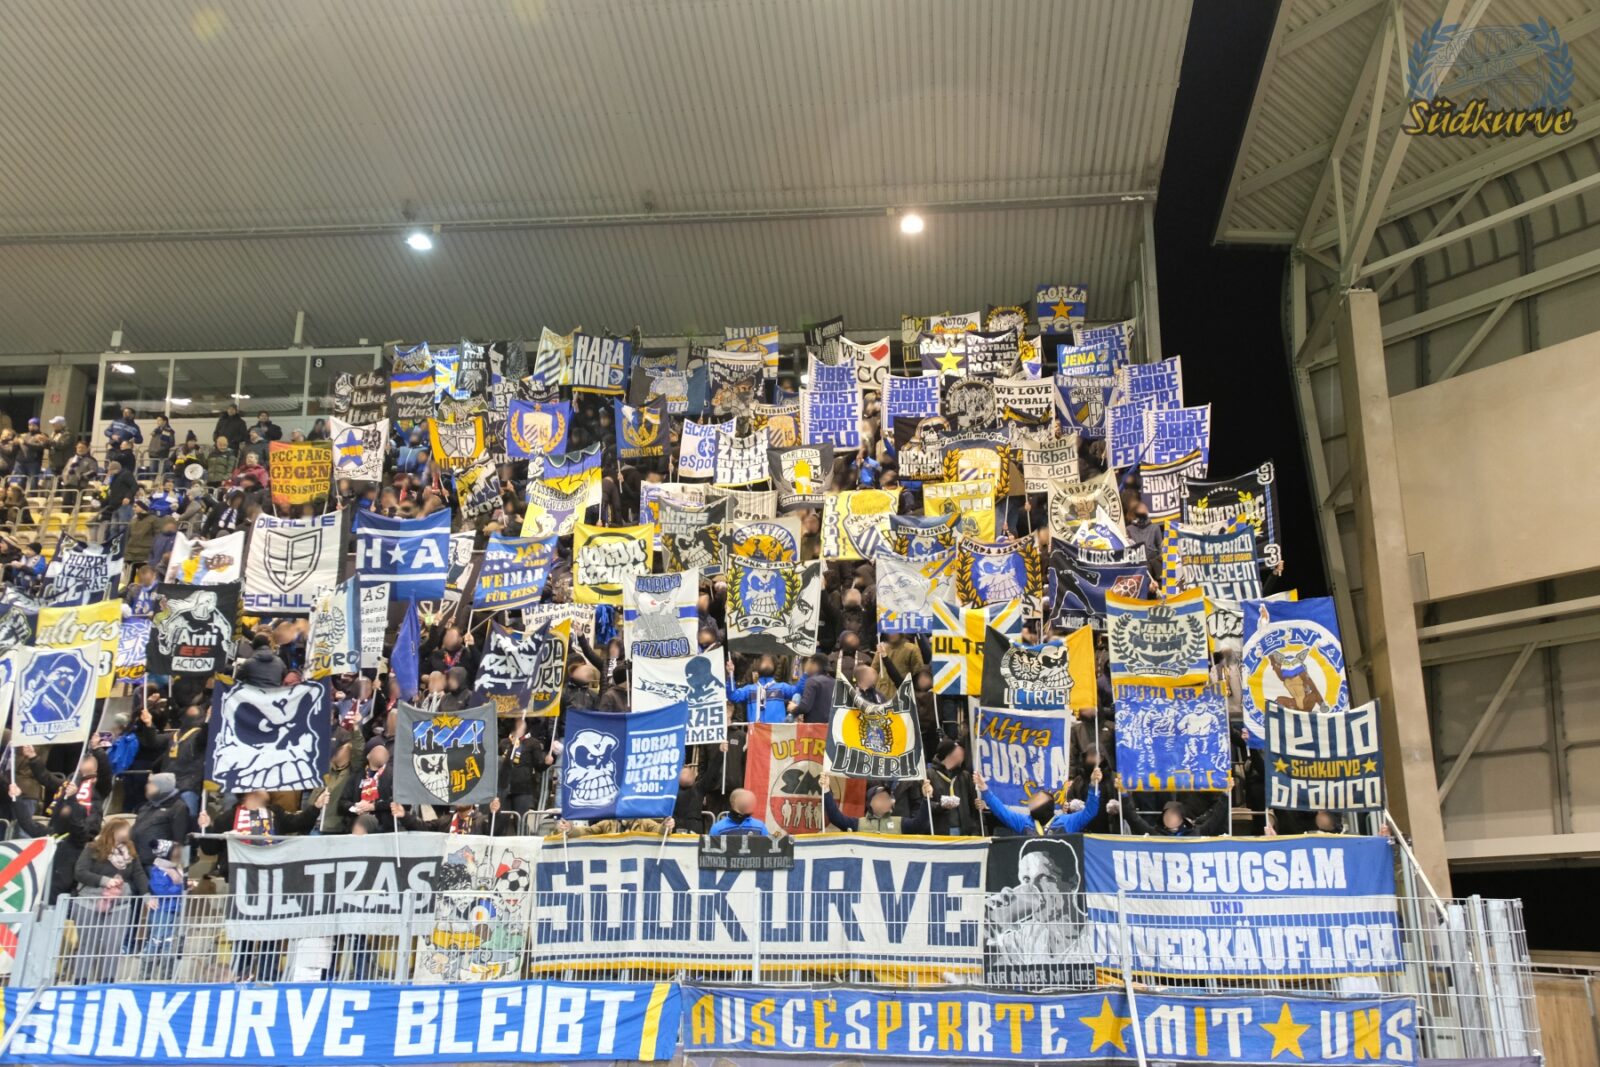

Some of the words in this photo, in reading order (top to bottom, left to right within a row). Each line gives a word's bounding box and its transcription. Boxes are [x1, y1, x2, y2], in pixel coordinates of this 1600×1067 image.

[1037, 285, 1087, 303] FORZA
[1082, 323, 1125, 340] ERNST
[576, 335, 625, 366] HARA
[967, 343, 1017, 354] FOOTBALL
[967, 352, 993, 362] NOT
[314, 358, 323, 368] 8
[462, 361, 486, 370] DICH
[1061, 351, 1097, 368] JENA
[1128, 358, 1178, 377] ERNST
[574, 359, 611, 388] KIRI
[815, 366, 856, 382] ABBE
[1056, 374, 1119, 388] TRADITION
[889, 376, 938, 390] ERNST
[995, 386, 1014, 395] WE
[1018, 385, 1052, 396] LOVE
[1129, 373, 1179, 395] ABBE
[810, 391, 857, 404] ERNST
[888, 388, 938, 403] ABBE
[996, 397, 1053, 405] FOOTBALL
[810, 404, 858, 419] ABBE
[887, 401, 938, 414] SPORT
[1112, 399, 1154, 418] ERNST
[1154, 407, 1208, 423] ERNST
[685, 419, 736, 438] SCHESS
[809, 419, 858, 432] SPORT
[1090, 427, 1106, 436] 190
[1111, 415, 1144, 435] ABB
[1154, 420, 1209, 439] ABBE
[809, 431, 859, 448] FELD
[1039, 438, 1067, 450] kein
[1111, 432, 1144, 449] SPOR
[1154, 436, 1208, 452] SPORT
[271, 449, 331, 463] FCC-FANS
[1026, 449, 1076, 464] fußball
[1111, 446, 1144, 468] FEL
[271, 465, 330, 479] GEGEN
[1047, 464, 1072, 477] den
[1257, 462, 1275, 486] 9
[256, 516, 278, 529] DIE
[356, 538, 383, 569] H
[411, 538, 446, 569] A
[961, 538, 992, 555] HORDA
[1077, 548, 1116, 563] ULTRAS
[1263, 543, 1282, 568] 3
[482, 568, 545, 589] WEIMAR
[243, 593, 312, 609] SCHUL
[484, 590, 507, 603] FÜR
[510, 584, 538, 599] ZEISS
[36, 609, 120, 645] ultras
[740, 616, 785, 628] GANG
[1141, 622, 1178, 634] JENA
[177, 628, 218, 647] Anti
[1143, 633, 1172, 643] CITY
[934, 637, 985, 656] ULTR
[1244, 626, 1343, 677] JENA
[174, 657, 213, 670] ACTION
[631, 732, 678, 755] HORDA
[772, 737, 826, 761] ULTR
[626, 748, 680, 771] AZZURO
[978, 739, 1068, 789] CURVA
[624, 764, 678, 785] ULTRAS
[1290, 758, 1361, 779] Südkurve
[634, 782, 661, 794] 2001
[1271, 775, 1385, 811] branco
[1111, 847, 1347, 893] UNBEUGSAM
[234, 860, 438, 918] ULTRAS
[536, 857, 982, 946] SÜDKURVE
[1209, 900, 1245, 915] UND
[1090, 919, 1399, 972] UNVERKÄUFLICH
[1010, 969, 1048, 984] IMMER
[1049, 968, 1071, 983] MIT
[9, 987, 371, 1059] SÜDKURVE
[393, 984, 636, 1057] BLEIBT
[690, 993, 1069, 1055] AUSGESPERRTE
[1144, 1004, 1253, 1059] MIT
[1320, 1006, 1414, 1063] UNS
